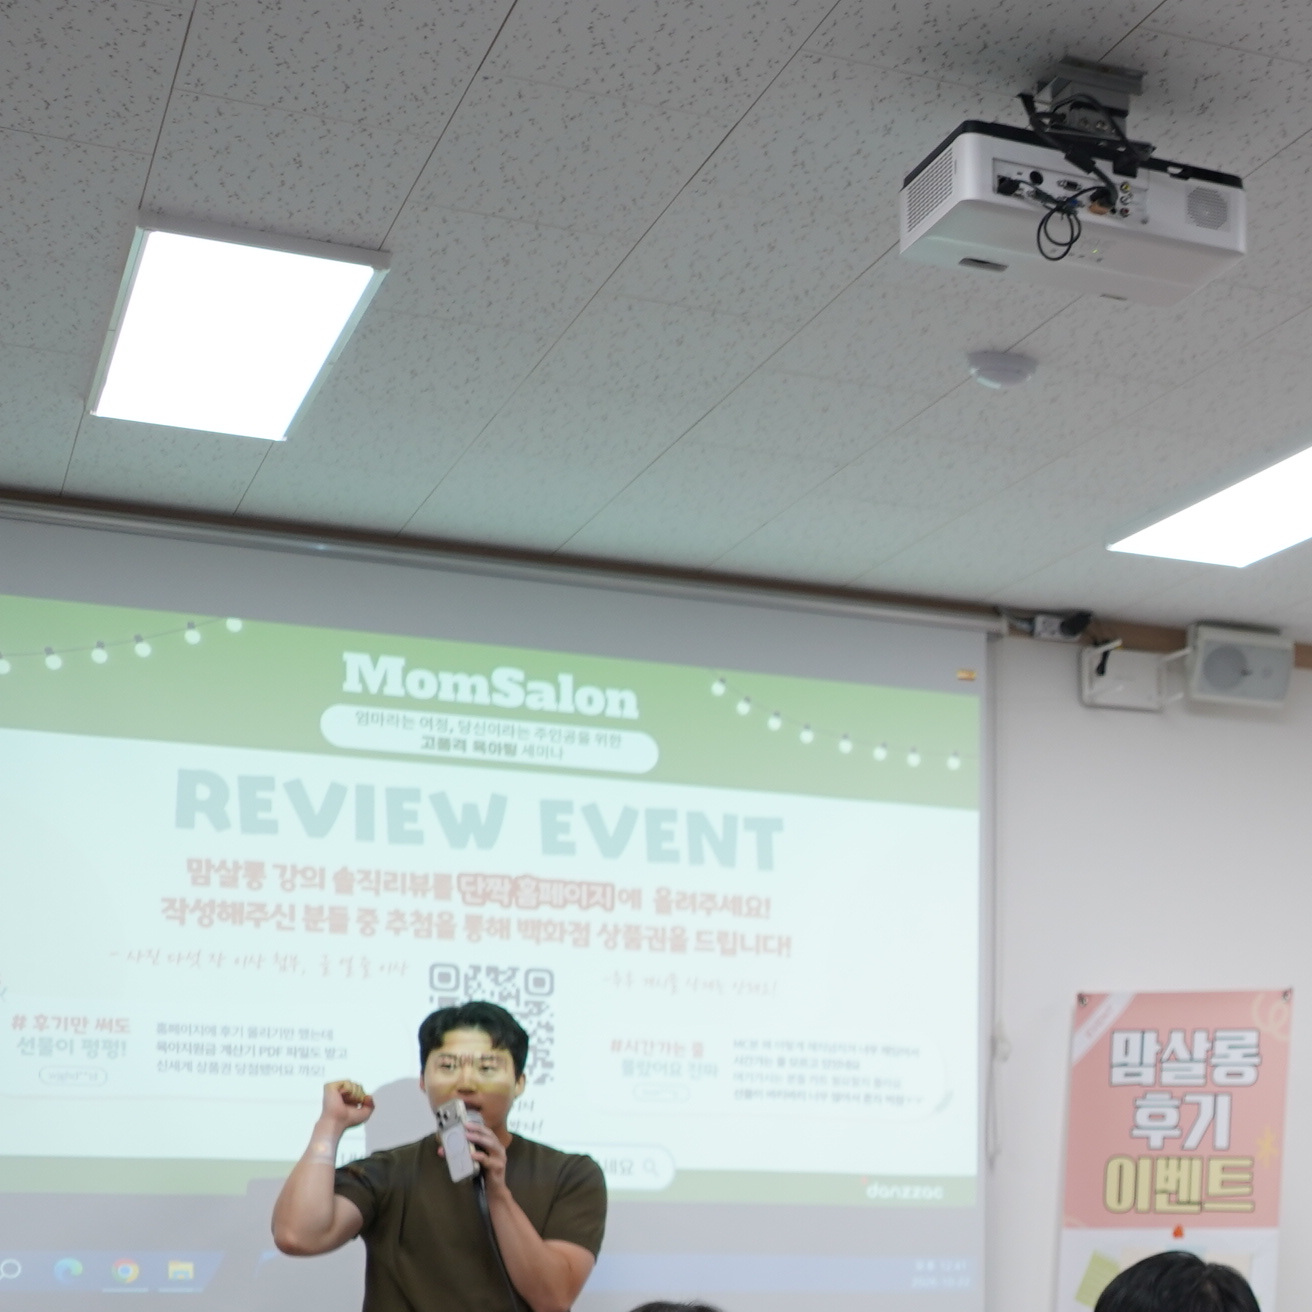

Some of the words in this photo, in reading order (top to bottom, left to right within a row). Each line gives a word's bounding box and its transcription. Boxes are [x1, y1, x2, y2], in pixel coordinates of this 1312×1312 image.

[342, 651, 639, 719] MomSalon
[521, 742, 565, 760] 세미나
[595, 733, 622, 750] 위한
[175, 768, 507, 850] REVIEW
[539, 799, 784, 871] EVENT
[272, 863, 326, 893] 강의
[332, 865, 453, 902] 솔직리뷰를
[457, 873, 513, 908] 단짝
[653, 886, 772, 920] 올려주세요!
[160, 896, 296, 932] 작성해주신
[302, 904, 350, 935] 분들
[356, 908, 380, 938] 중
[385, 909, 458, 942] 추첨을
[464, 913, 512, 944] 통해
[517, 917, 591, 949] 백화점
[597, 922, 688, 952] 상품권을
[694, 929, 793, 959] 드립니다!
[11, 1013, 27, 1031] #
[33, 1013, 89, 1035] 후기만
[95, 1016, 132, 1035] 써도
[17, 1035, 75, 1058] 선물이
[259, 1046, 282, 1058] PDF
[1108, 1027, 1262, 1088] 맘살롱
[1130, 1091, 1233, 1152] 후기
[1103, 1155, 1257, 1215] 이벤트
